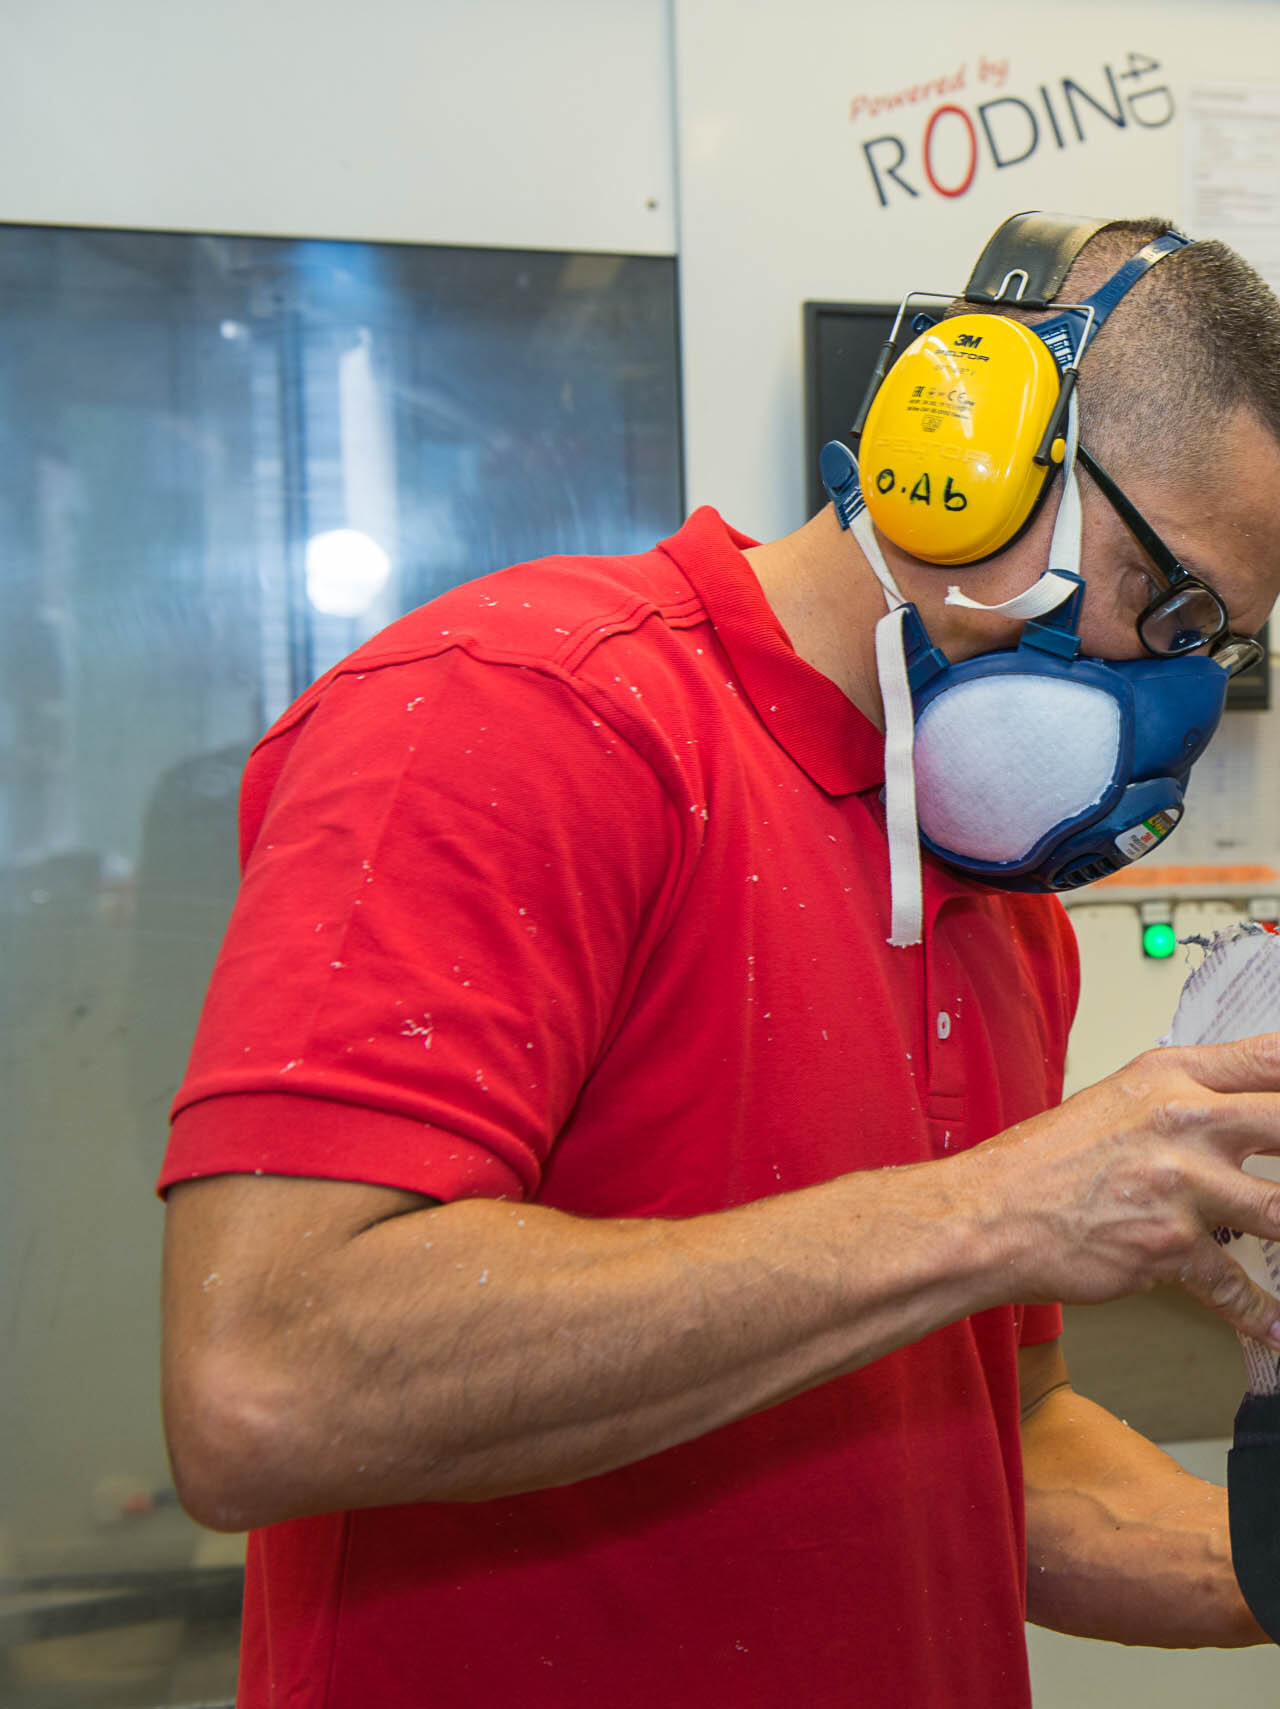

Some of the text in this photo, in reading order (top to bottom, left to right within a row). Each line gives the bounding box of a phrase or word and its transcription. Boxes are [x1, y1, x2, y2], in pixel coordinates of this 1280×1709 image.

[850, 56, 1009, 122] Powered by
[862, 64, 1127, 207] RODIN
[935, 349, 990, 362] PELTOR
[954, 334, 983, 349] 3M
